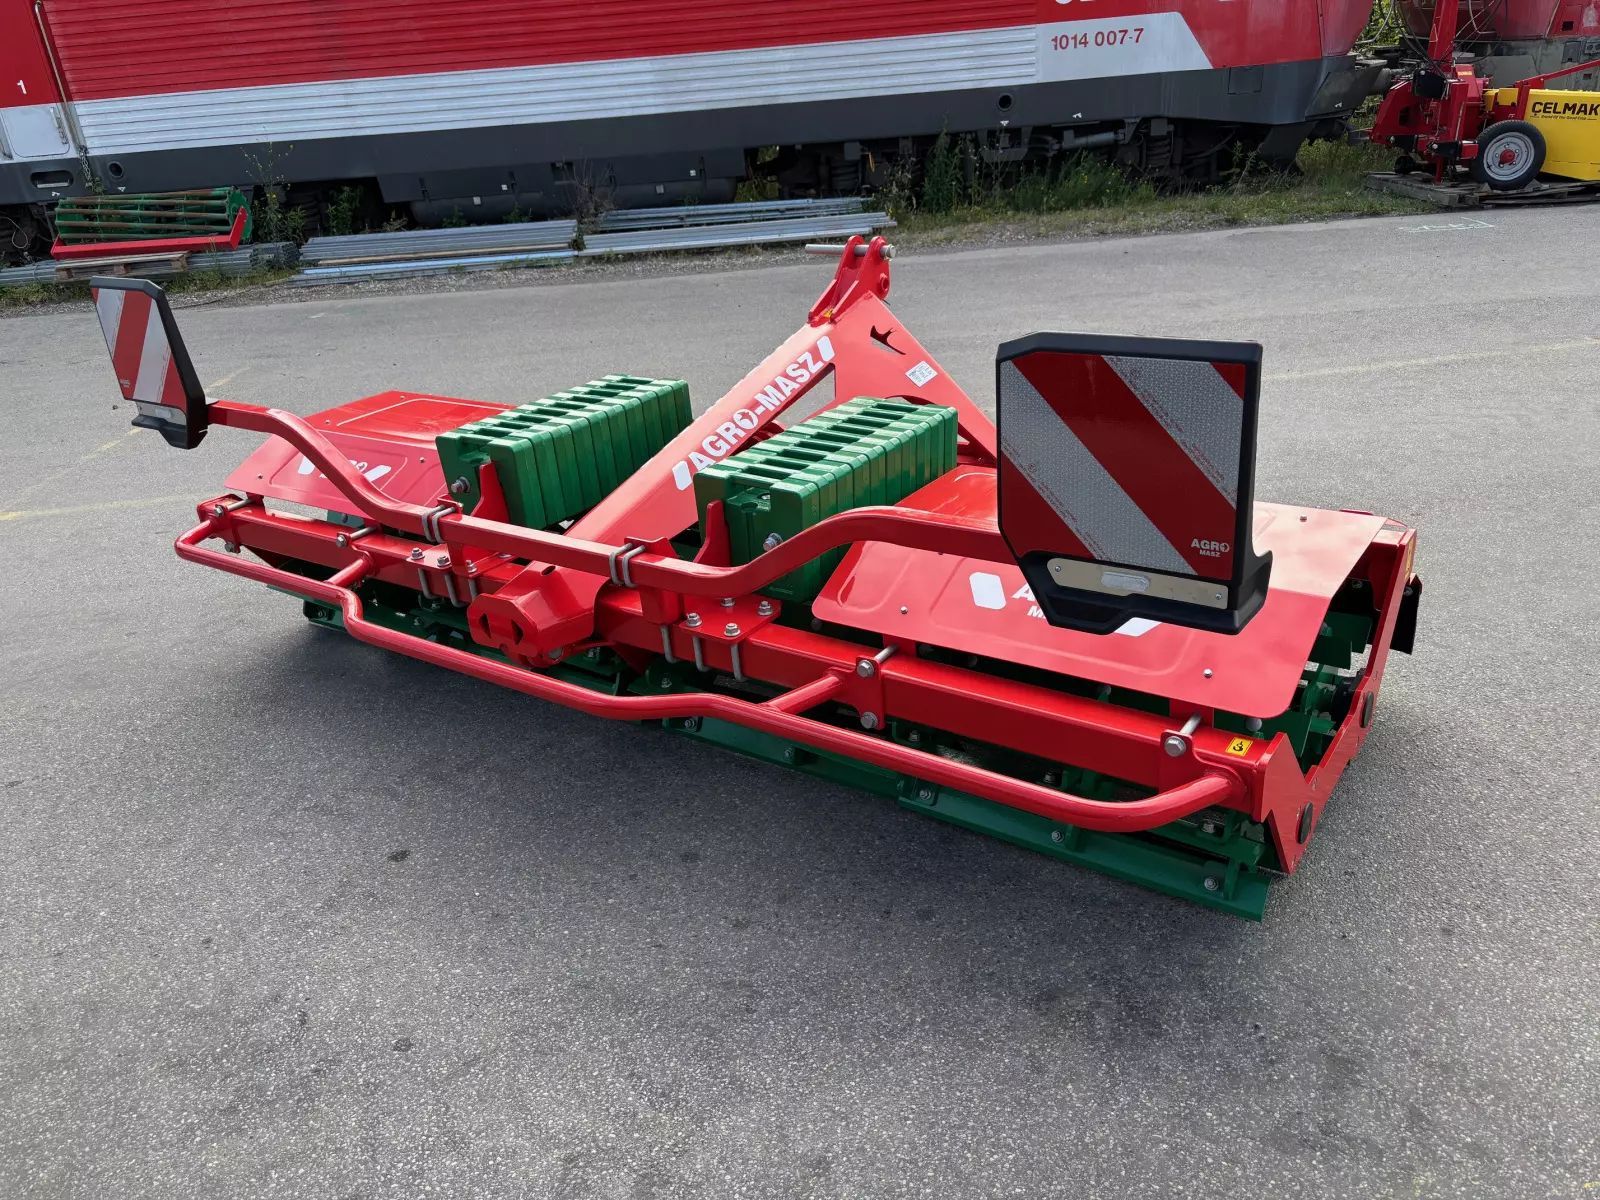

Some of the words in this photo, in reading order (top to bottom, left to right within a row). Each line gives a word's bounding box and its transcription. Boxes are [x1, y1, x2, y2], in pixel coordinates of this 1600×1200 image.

[1051, 33, 1089, 51] 1014
[1094, 27, 1145, 47] 007-7
[16, 79, 28, 95] 1
[688, 351, 825, 472] AGRO-MASZ
[1190, 537, 1231, 553] AGRO
[1199, 549, 1222, 558] MASZ
